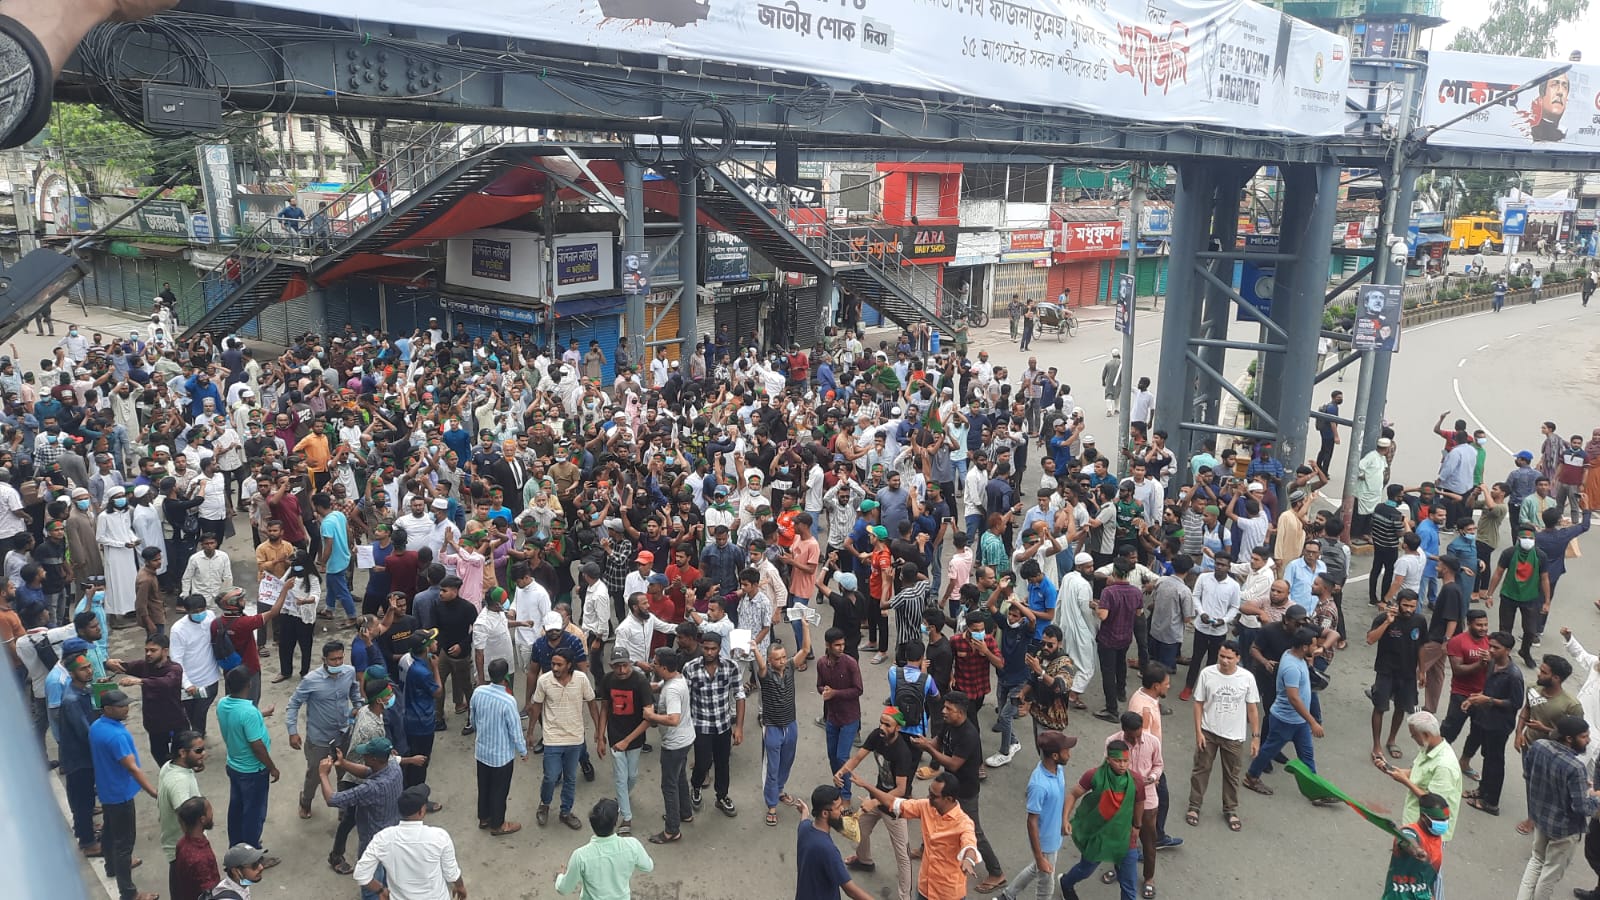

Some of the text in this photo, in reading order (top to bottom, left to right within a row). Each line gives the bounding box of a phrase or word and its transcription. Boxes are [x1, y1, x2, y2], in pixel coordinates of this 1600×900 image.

[757, 0, 888, 47] জাতীয় শোক দিবস
[962, 35, 977, 58] ১৫
[1030, 49, 1055, 72] সকল
[914, 231, 945, 244] ZARA
[914, 244, 946, 254] BABY SHOP
